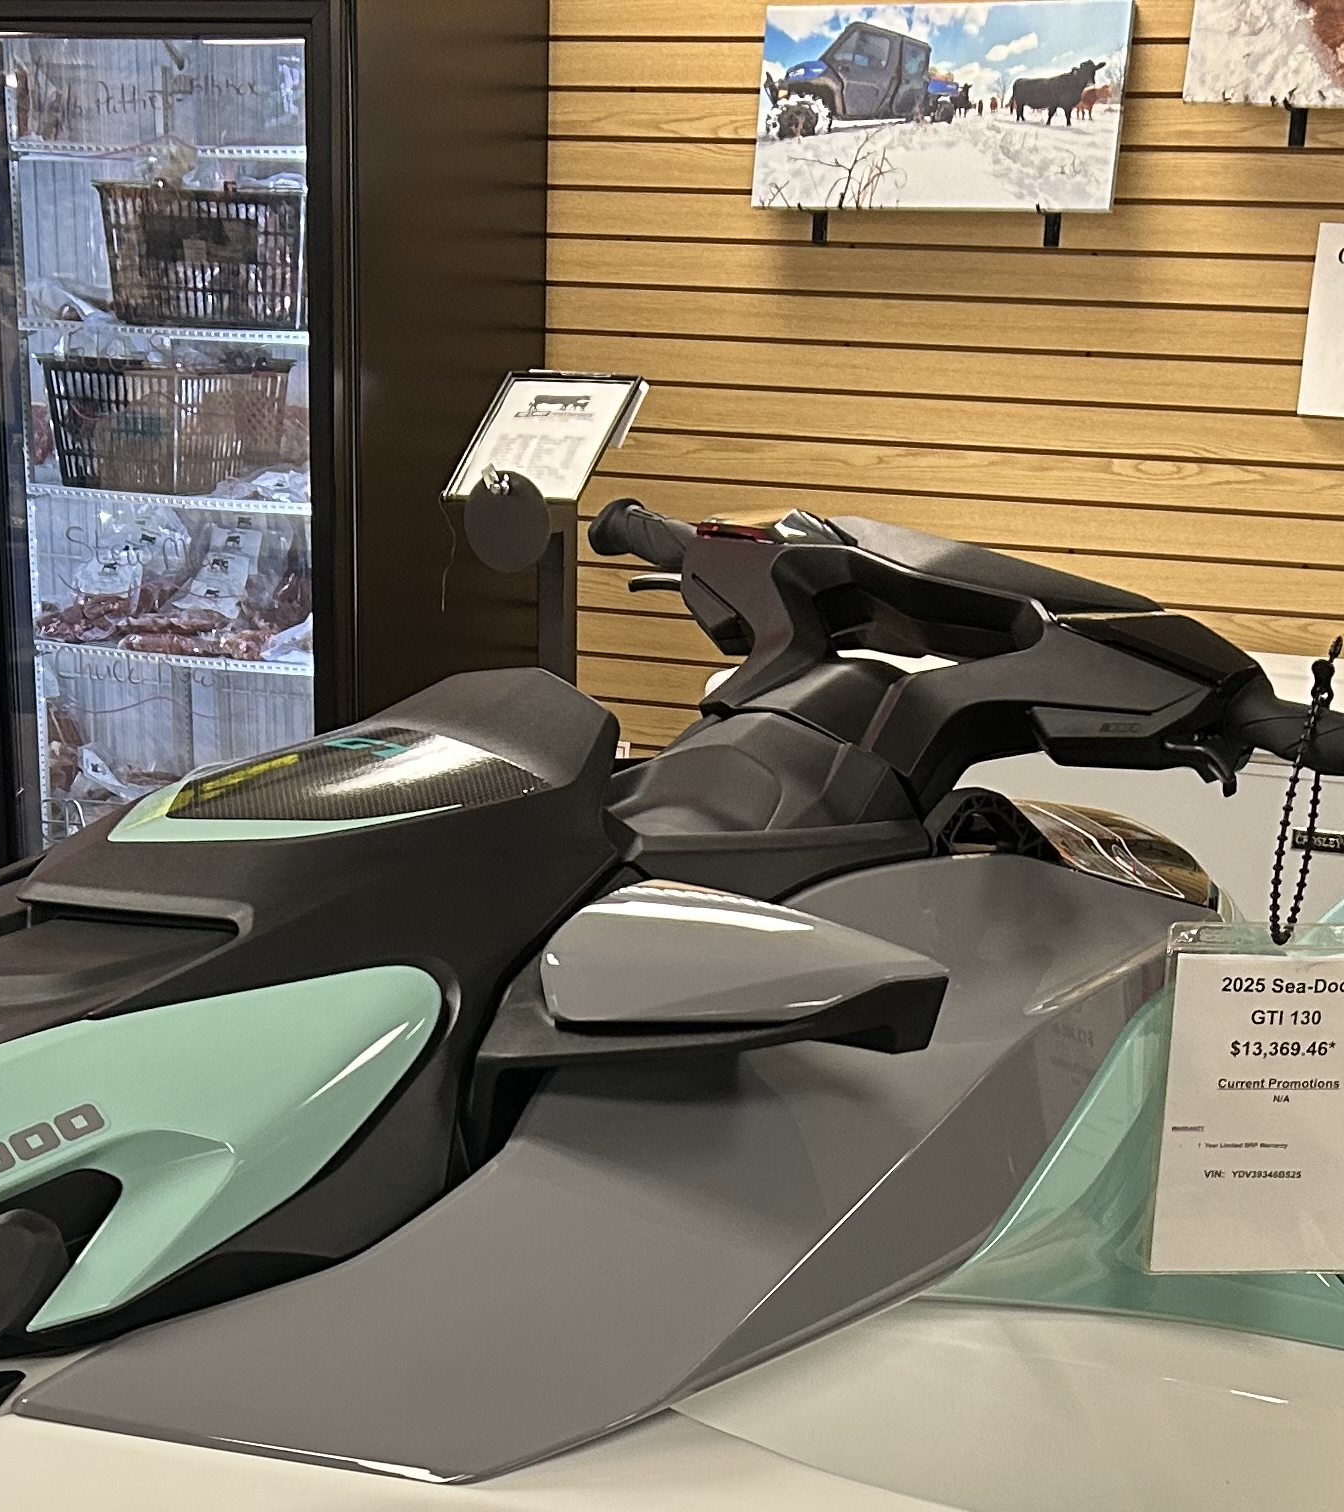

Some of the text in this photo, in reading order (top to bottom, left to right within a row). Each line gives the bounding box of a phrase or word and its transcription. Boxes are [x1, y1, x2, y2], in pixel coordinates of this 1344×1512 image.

[1221, 977, 1266, 993] 2025
[1251, 1009, 1322, 1026] GTI 130
[1217, 1078, 1341, 1090] Current Promotions
[1272, 1095, 1290, 1103] N/A
[1203, 1169, 1226, 1179] VIN:
